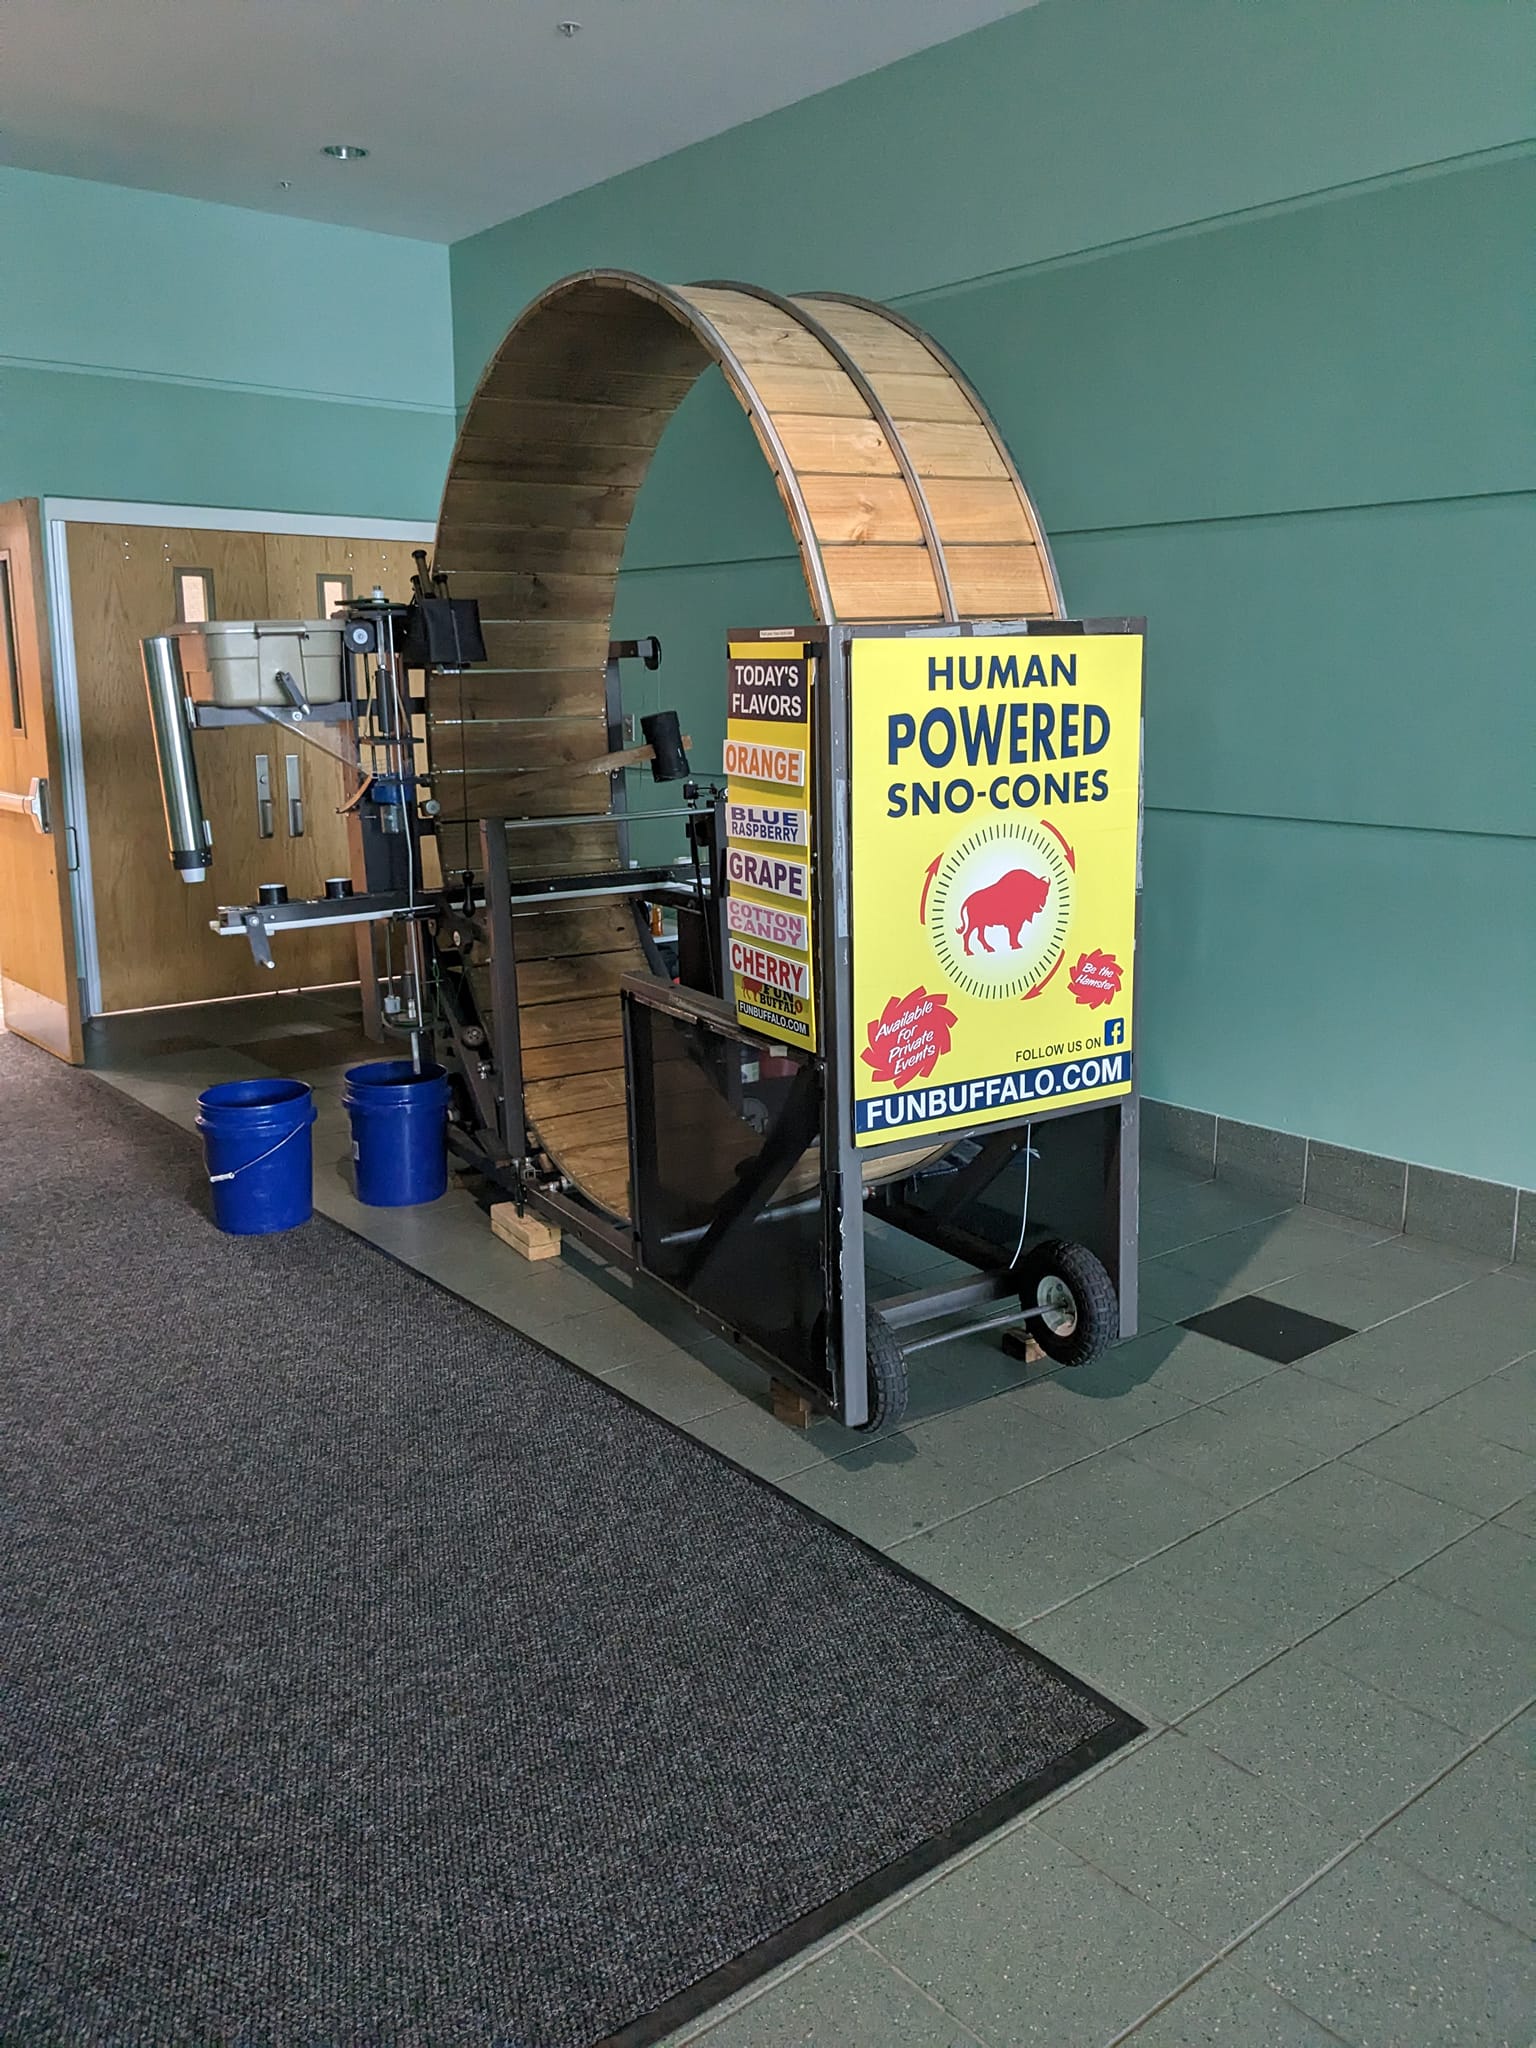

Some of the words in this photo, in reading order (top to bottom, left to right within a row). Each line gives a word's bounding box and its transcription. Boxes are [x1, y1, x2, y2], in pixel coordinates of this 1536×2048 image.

[734, 665, 799, 688] TODAY'S
[928, 653, 1077, 691] HUMAN
[732, 693, 802, 717] FLAVORS
[887, 702, 1111, 769] POWERED
[725, 744, 800, 783] ORANGE
[887, 769, 1109, 818] SNO-CONES
[730, 806, 799, 827] BLUE
[731, 821, 799, 843] RASPBERRY
[729, 852, 803, 897] GRAPE
[729, 902, 802, 932] COTTON
[730, 915, 801, 946] CANDY
[731, 943, 804, 993] CHERRY
[1075, 974, 1115, 990] Hamster
[1082, 962, 1097, 975] Be
[1098, 966, 1114, 978] the
[763, 984, 794, 1003] FUN
[739, 1002, 807, 1035] FUNBUFFALO.COM
[875, 1001, 933, 1042] Available
[888, 1030, 934, 1064] Private
[894, 1045, 936, 1075] Events
[1015, 1043, 1065, 1063] FOLLOW
[1067, 1040, 1083, 1053] US
[1085, 1037, 1102, 1050] ON
[866, 1055, 1123, 1129] FUNBUFFALO.COM
